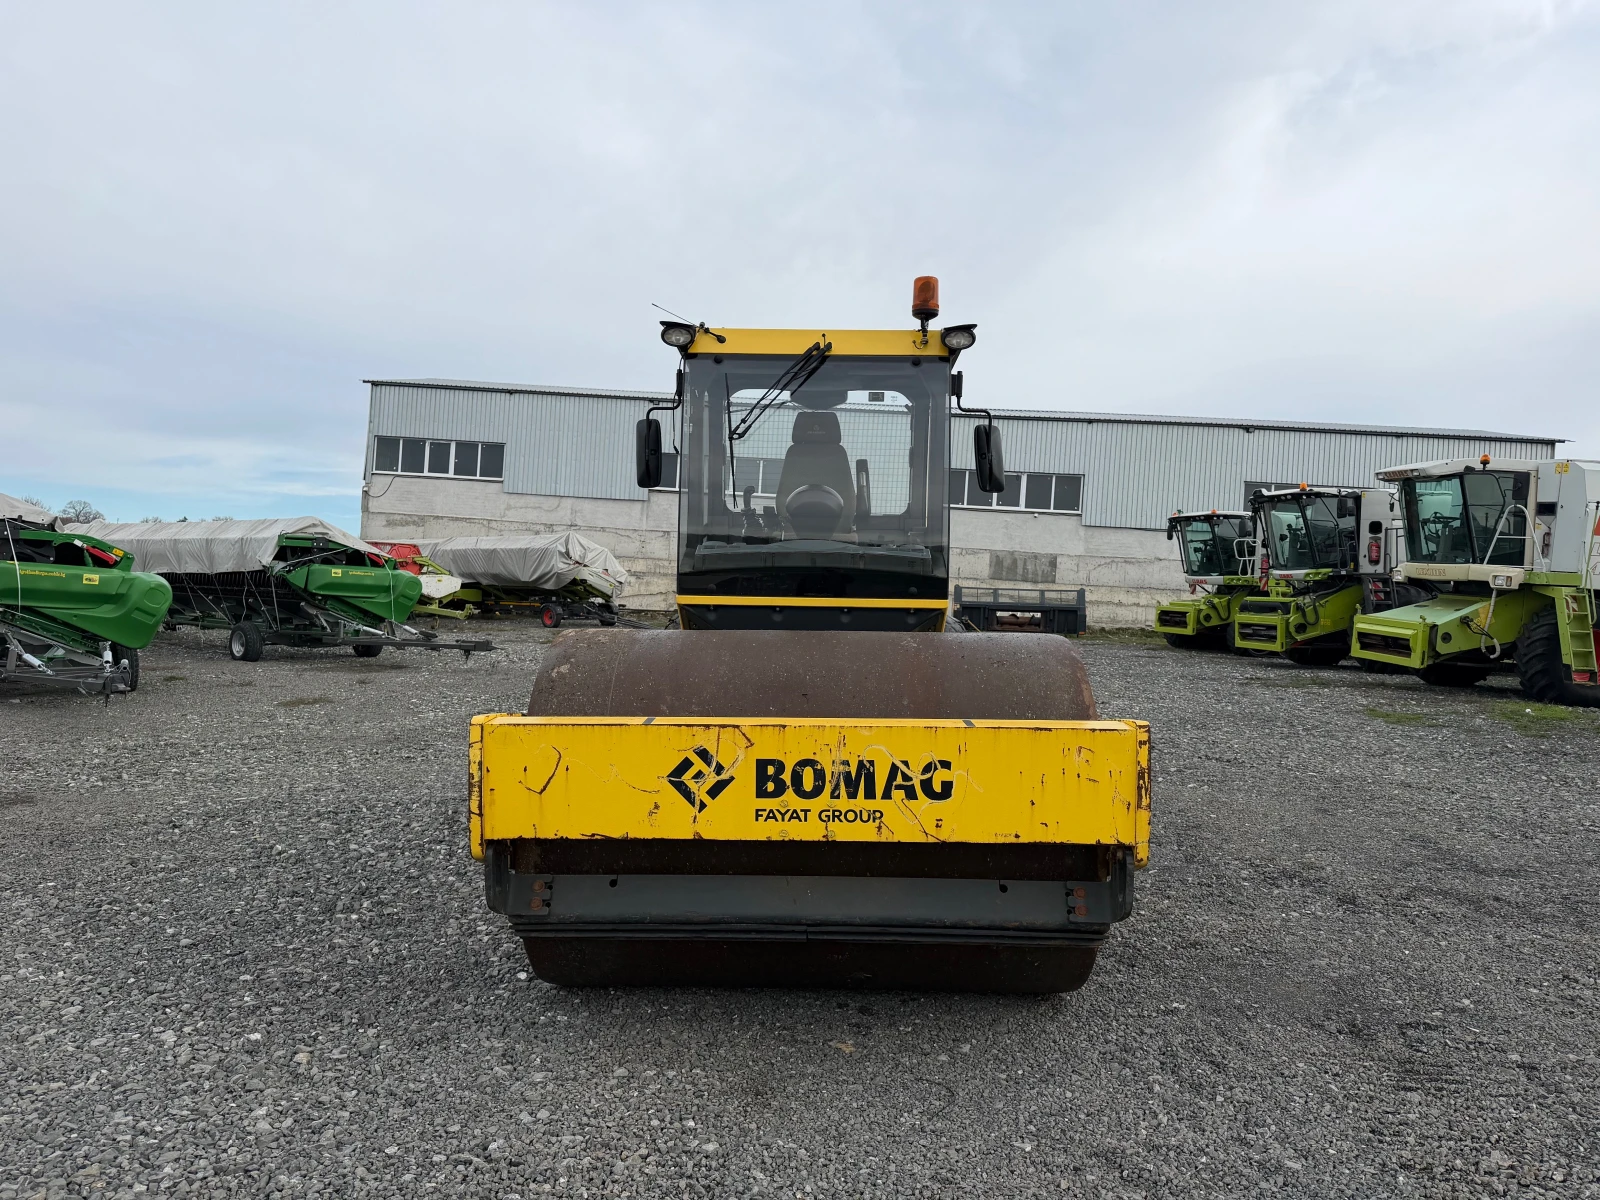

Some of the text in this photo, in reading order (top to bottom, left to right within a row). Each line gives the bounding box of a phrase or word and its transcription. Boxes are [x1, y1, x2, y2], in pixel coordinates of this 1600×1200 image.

[755, 758, 954, 801] BOMAG
[754, 808, 884, 824] FAYAT GROUP
